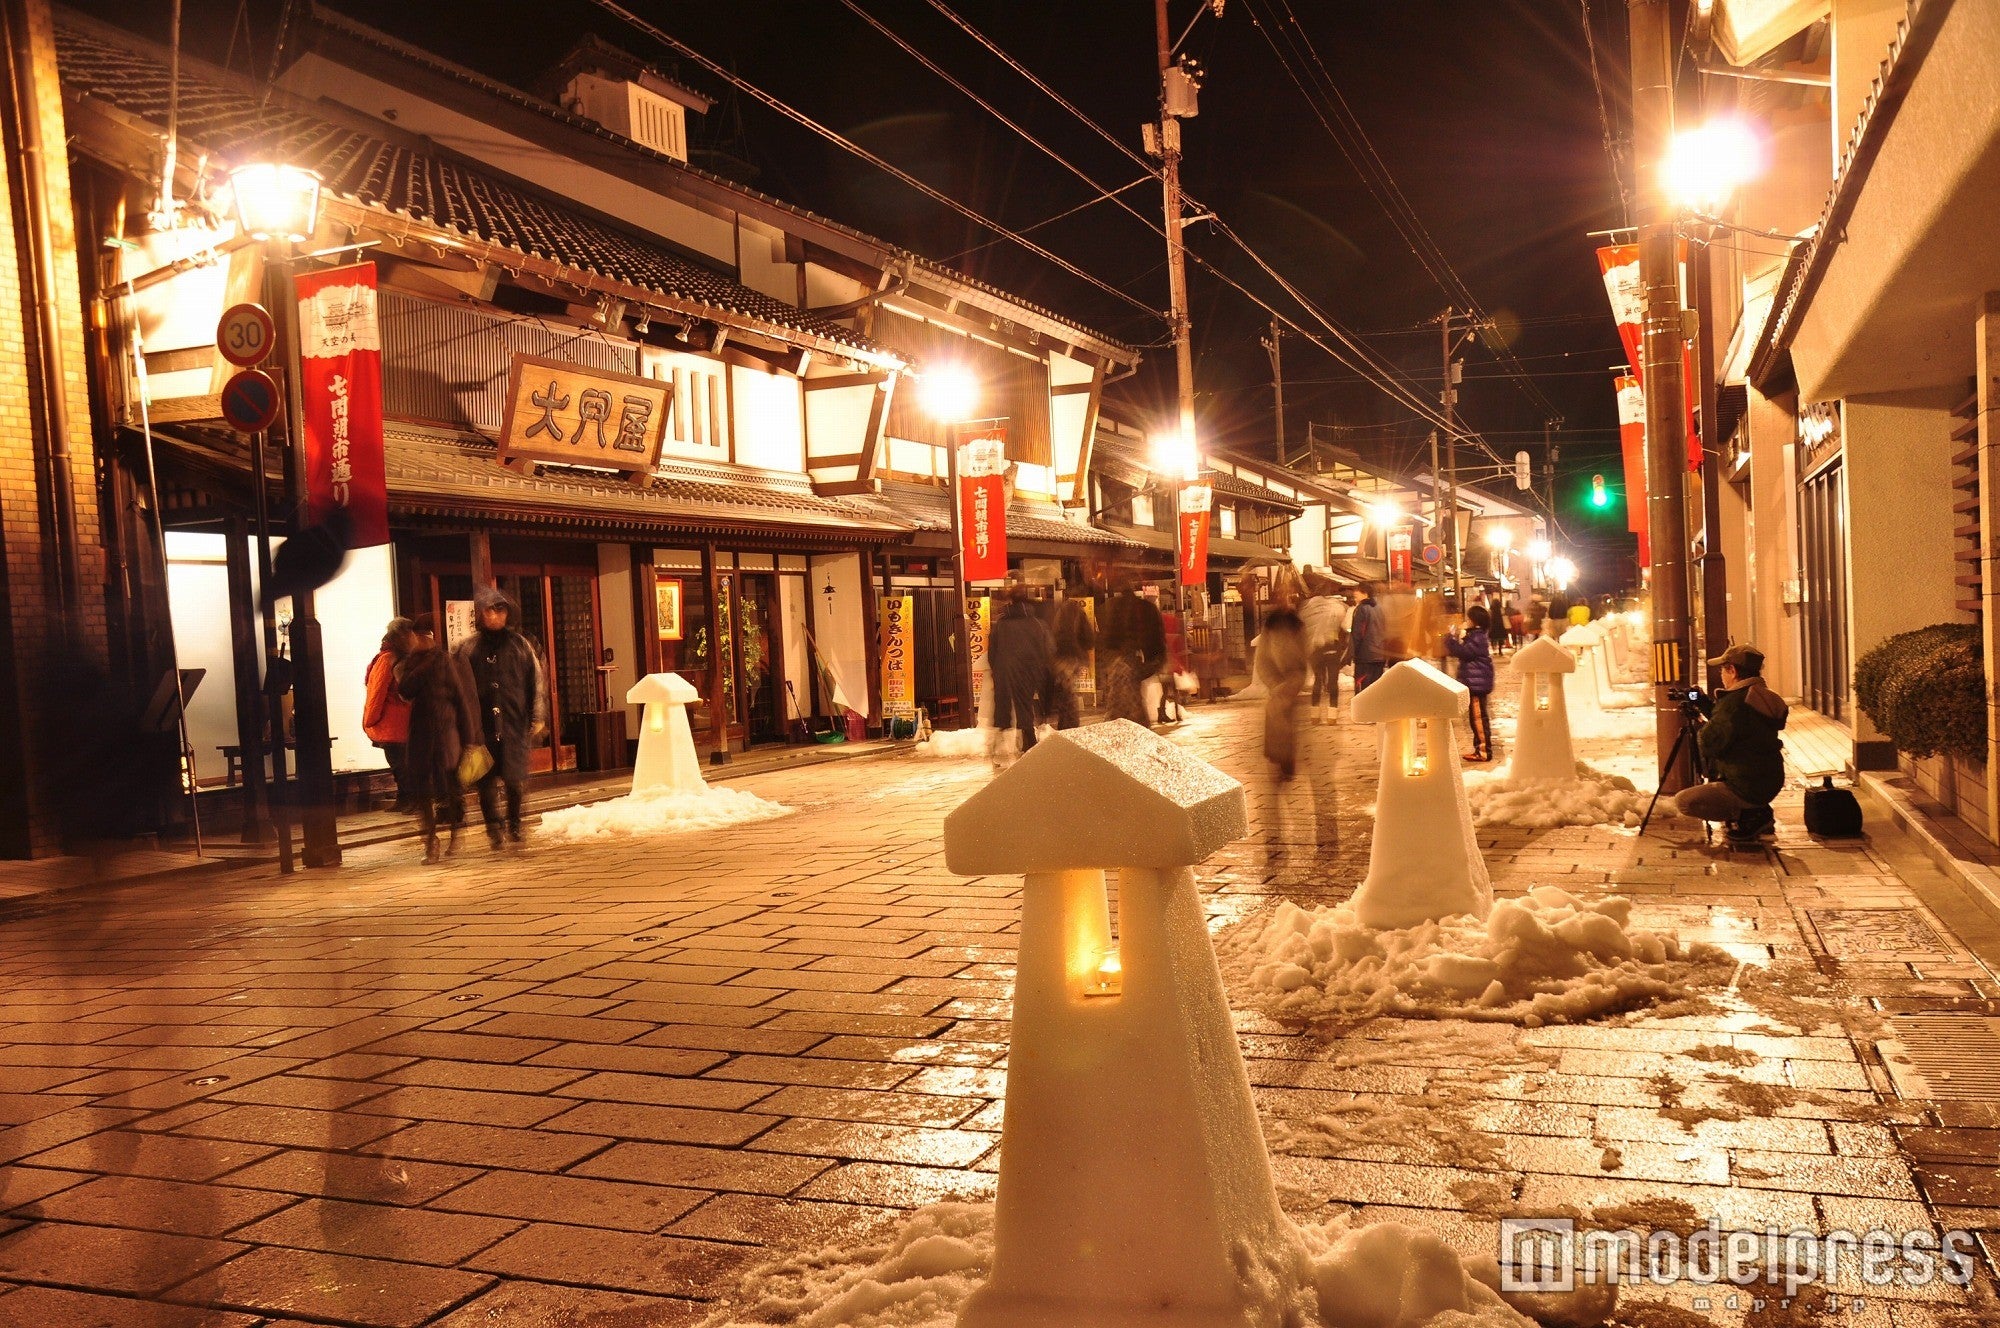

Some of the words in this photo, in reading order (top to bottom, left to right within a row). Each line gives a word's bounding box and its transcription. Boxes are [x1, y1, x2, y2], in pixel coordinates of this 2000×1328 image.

[229, 321, 262, 350] 30
[973, 486, 990, 559] 七間朝市通り
[886, 599, 904, 671] いもきんつば
